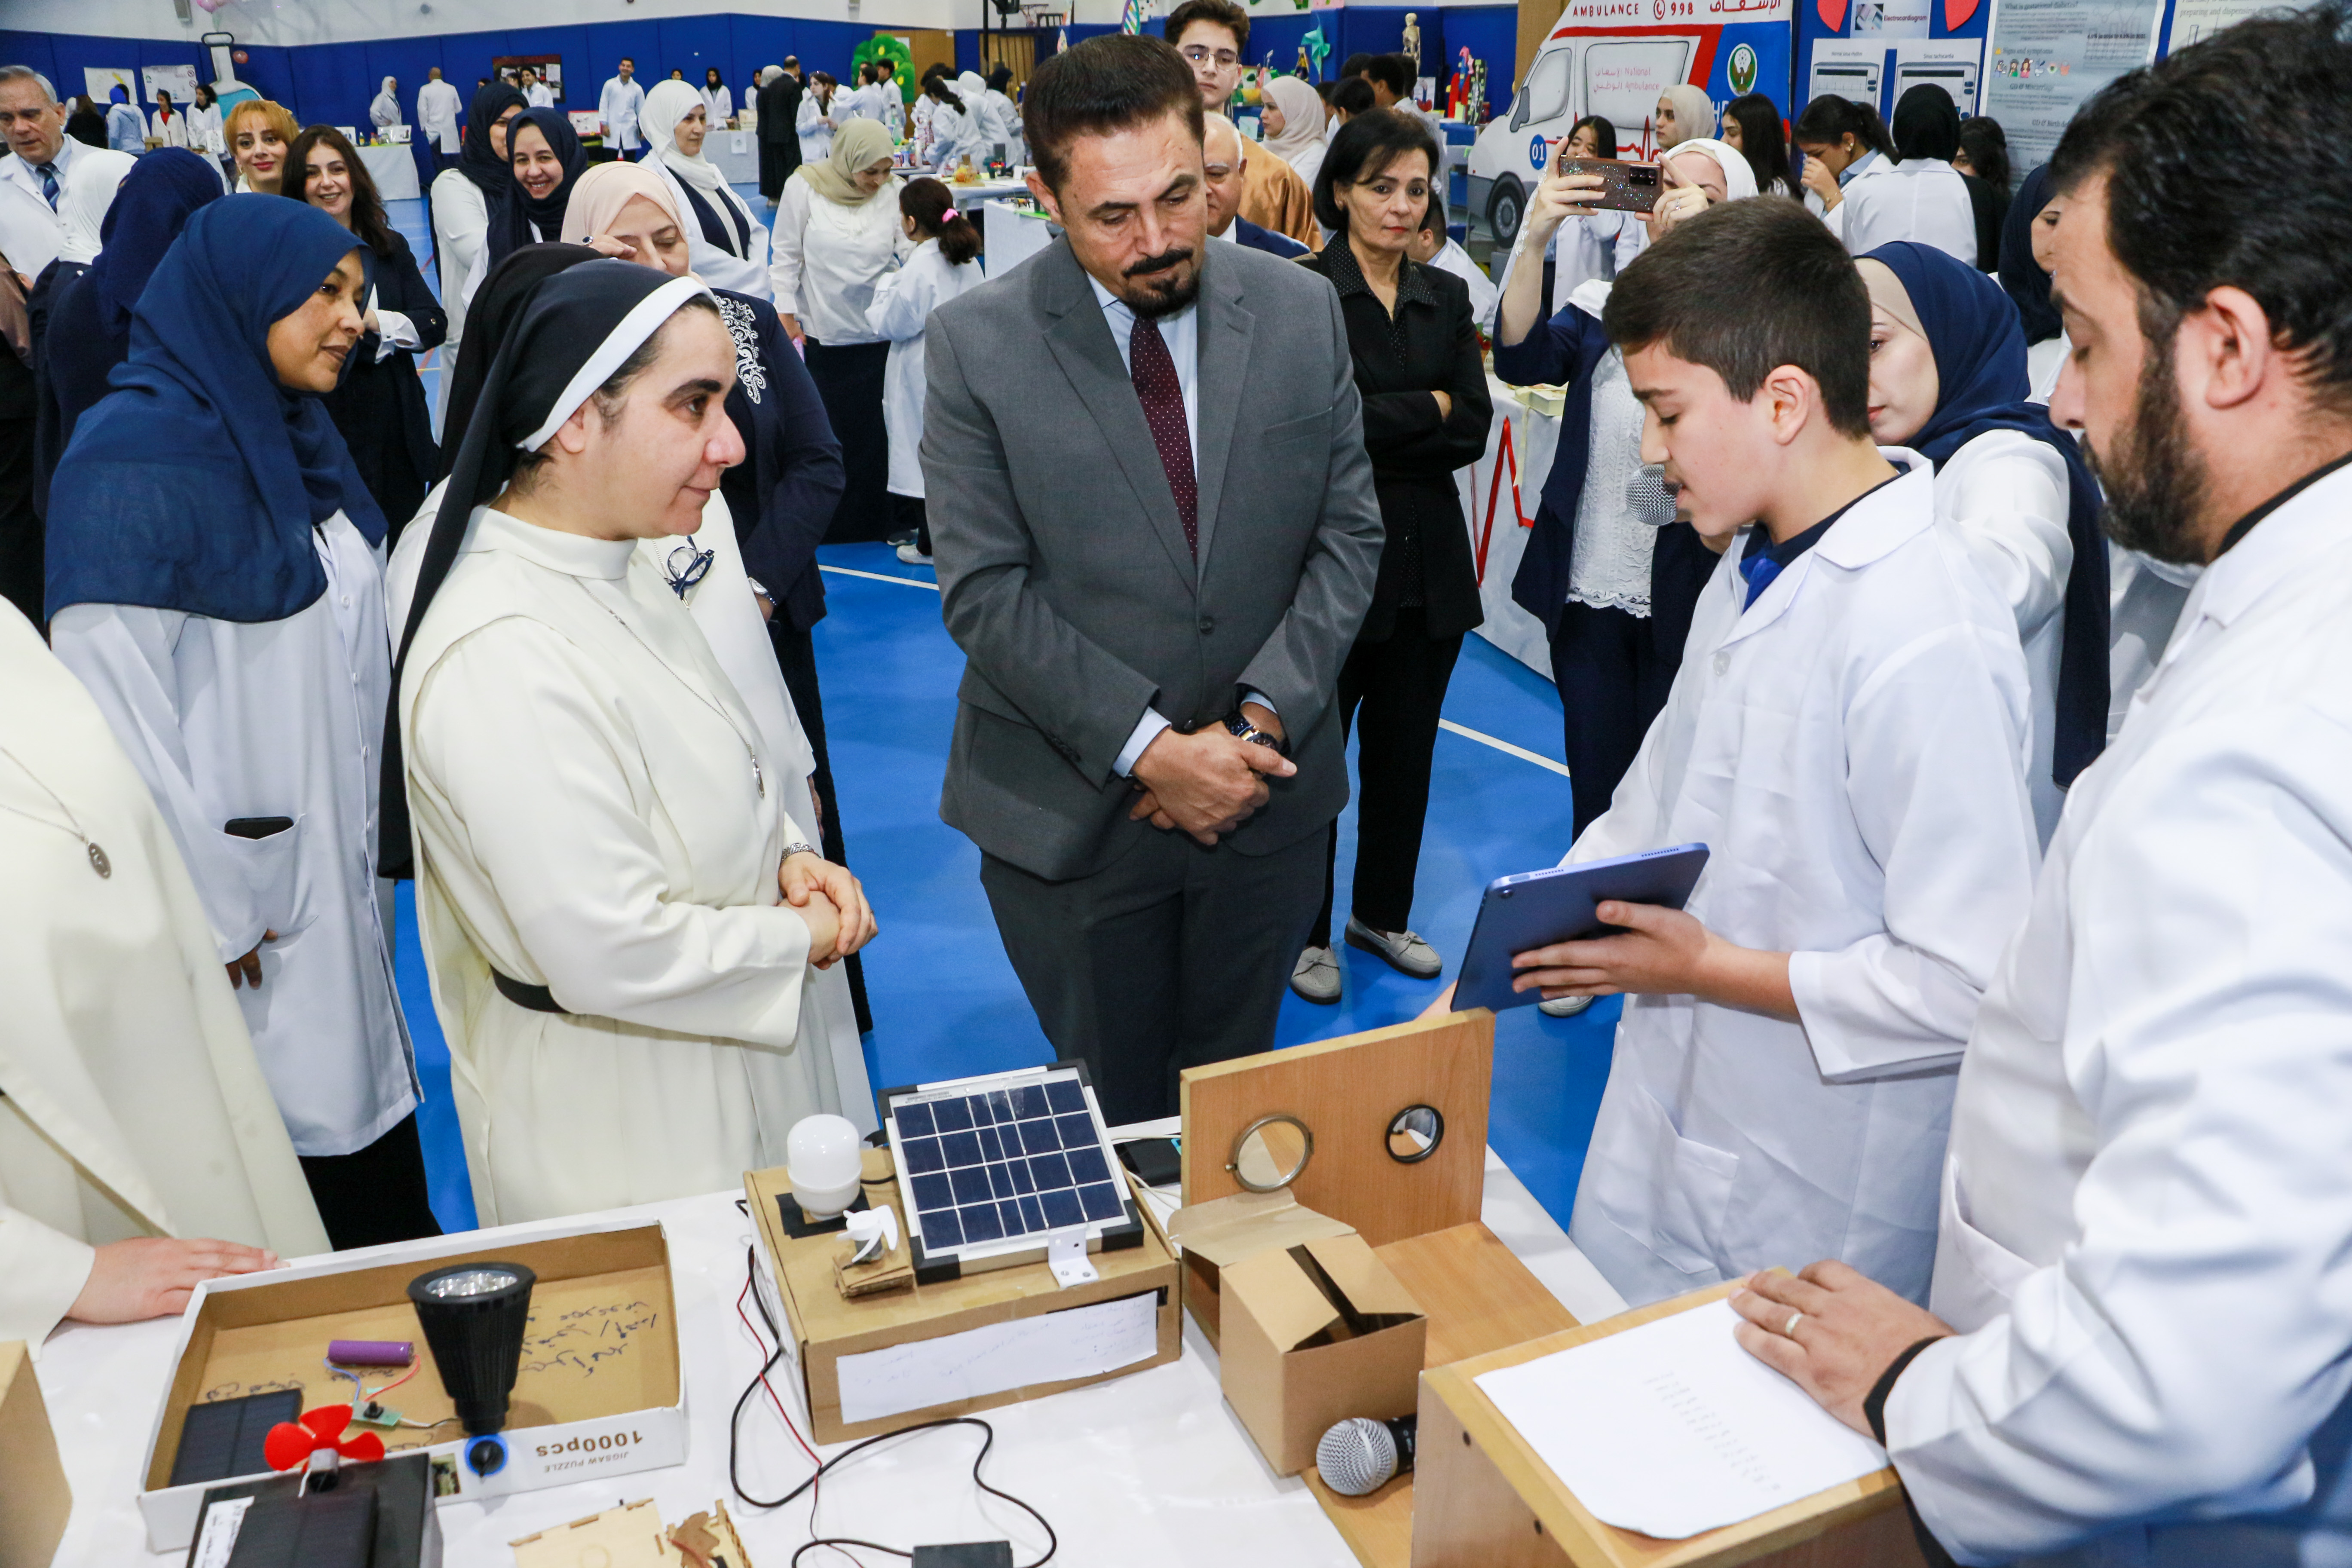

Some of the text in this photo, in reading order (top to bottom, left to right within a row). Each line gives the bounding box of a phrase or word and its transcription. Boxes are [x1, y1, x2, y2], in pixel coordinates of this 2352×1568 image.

[1573, 3, 1694, 17] AMBULANCE 998
[2180, 9, 2208, 18] preparing
[1625, 67, 1651, 76] National
[1625, 80, 1660, 91] Ambulance
[1532, 143, 1545, 161] 01
[536, 1430, 643, 1457] 1000pcs
[544, 1451, 629, 1473] JIGSAW PUZZLE
